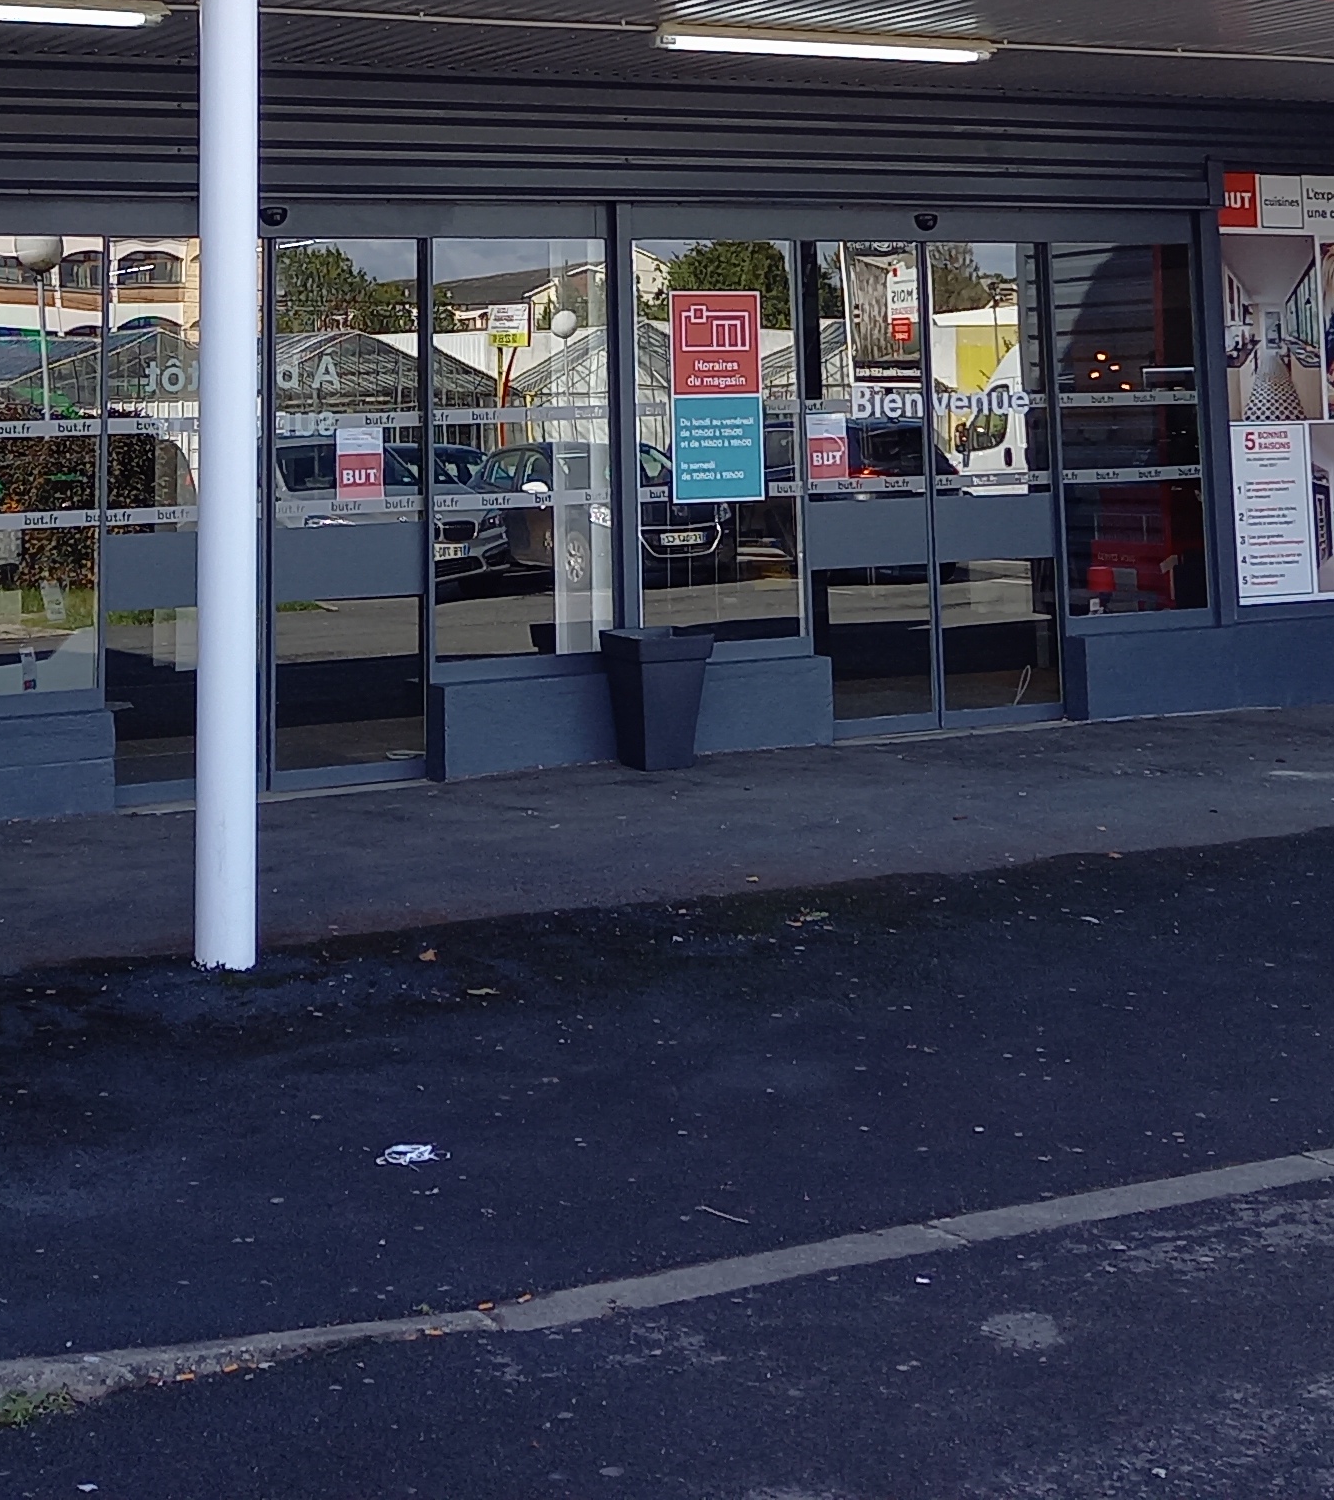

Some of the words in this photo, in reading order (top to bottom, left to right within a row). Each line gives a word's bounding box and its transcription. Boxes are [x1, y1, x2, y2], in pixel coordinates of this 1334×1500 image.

[1263, 196, 1300, 208] cuisines
[1307, 208, 1328, 219] une
[694, 359, 739, 372] Horaires
[687, 375, 701, 387] du
[703, 376, 746, 389] magasin
[852, 385, 1031, 419] Bienvenue
[364, 413, 395, 426] but.fr
[57, 421, 92, 433] but.fr
[1244, 431, 1256, 451] 5
[1258, 441, 1291, 450] RAISONS
[812, 451, 843, 467] BUT
[341, 469, 378, 485] BUT
[1096, 470, 1119, 480] but.fr
[1138, 469, 1161, 479] but.fr
[837, 480, 863, 491] but.fr
[884, 478, 910, 489] but.fr
[1237, 486, 1242, 495] 1
[331, 501, 362, 513] but.fr
[384, 498, 415, 511] but.fr
[481, 495, 511, 507] but.fr
[24, 514, 59, 526] but.fr
[105, 510, 132, 524] ut.fr
[157, 508, 190, 521] but.fr
[1238, 512, 1245, 522] 2
[1239, 535, 1246, 545] 3
[1241, 555, 1248, 564] 4
[1242, 576, 1249, 585] 5
